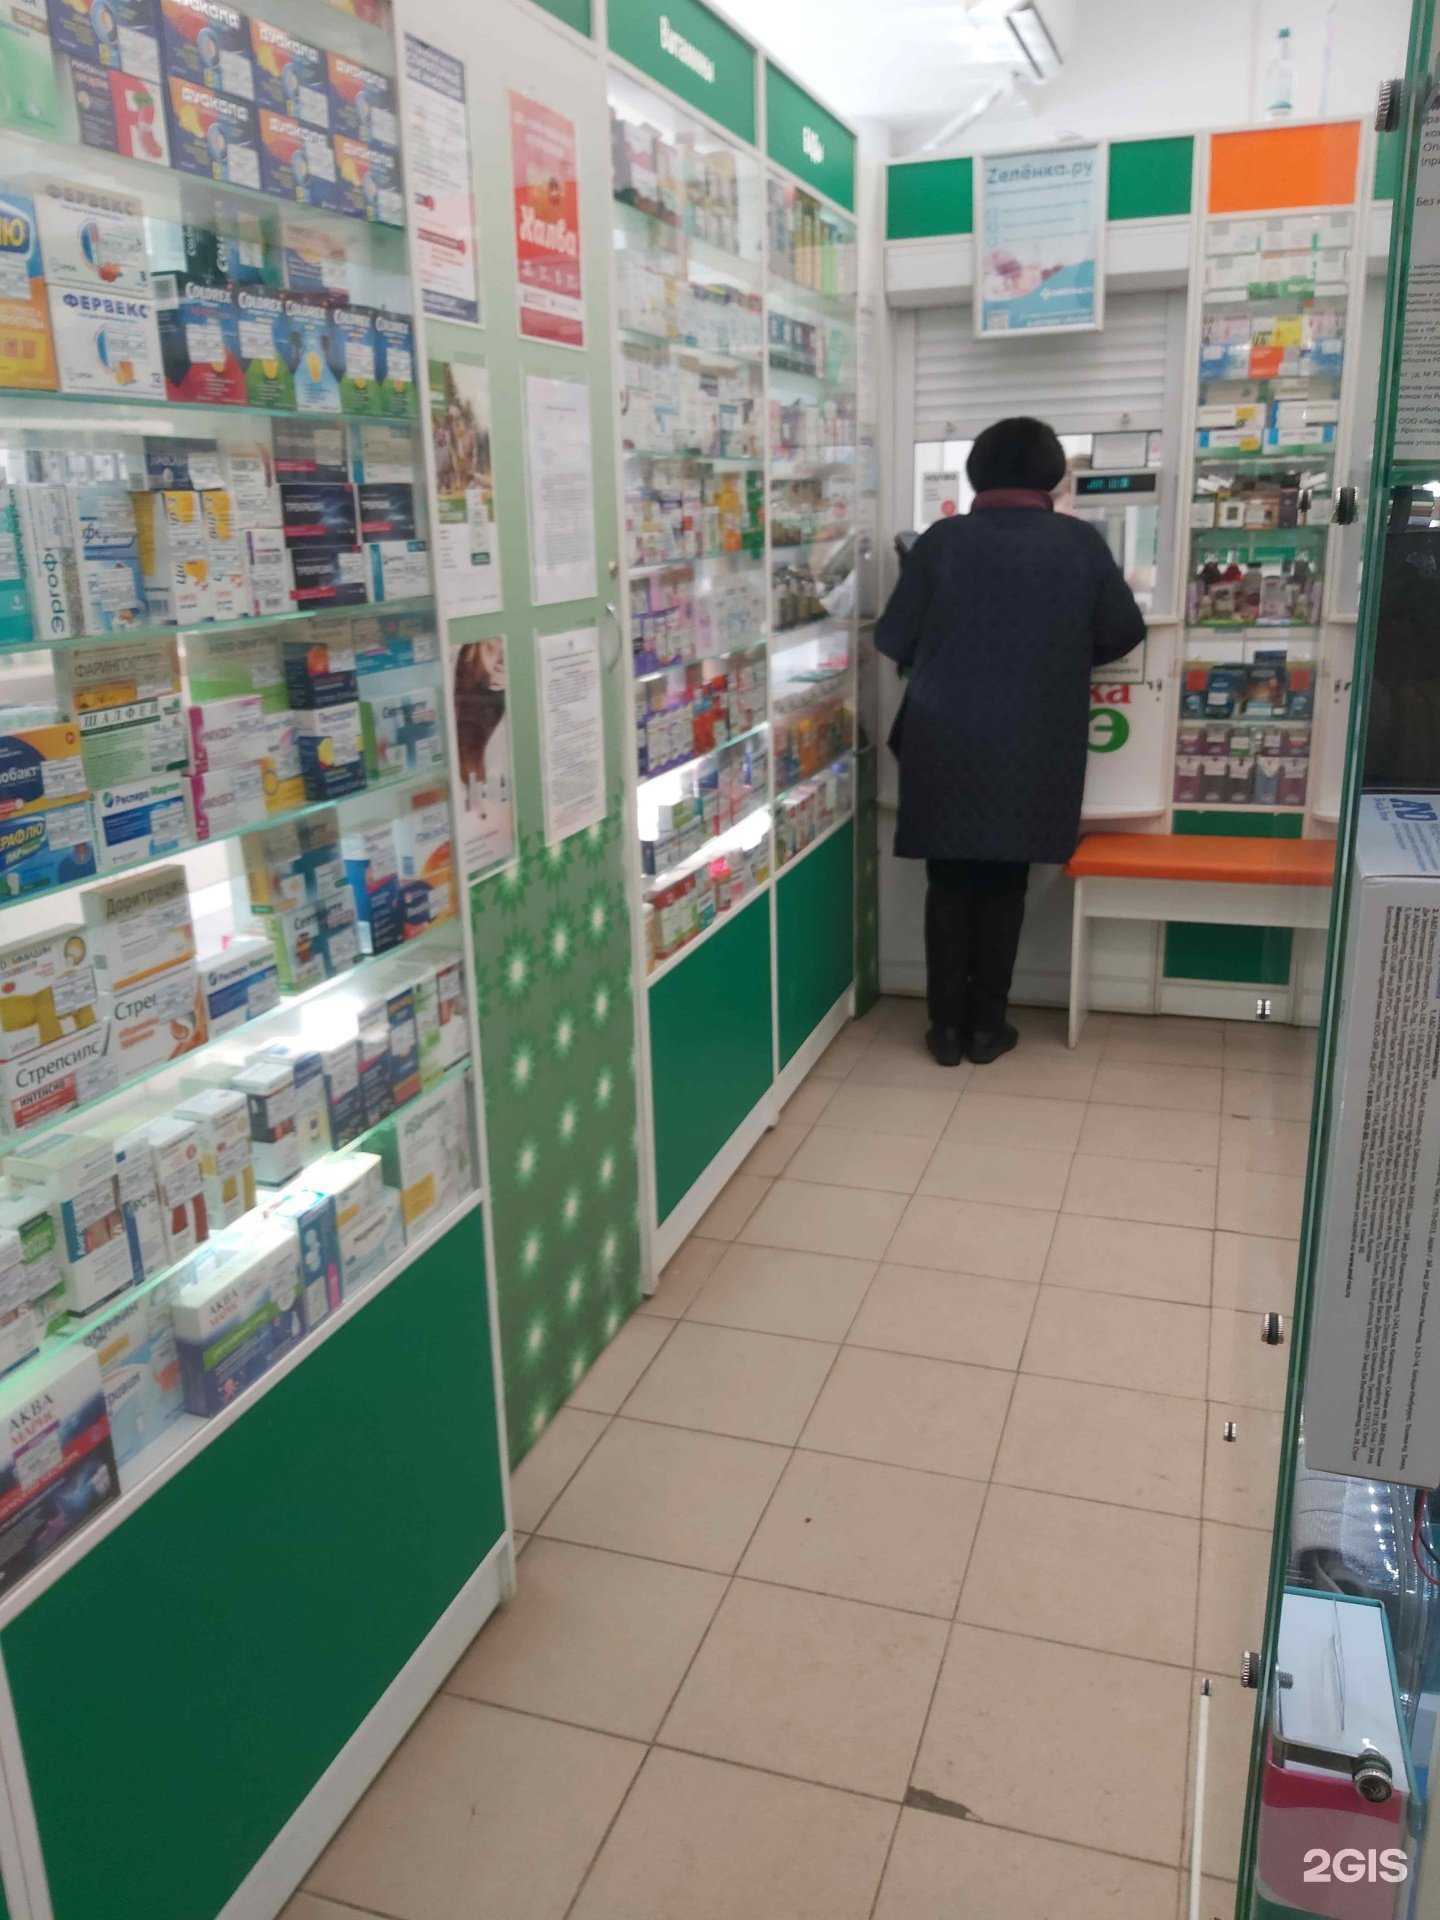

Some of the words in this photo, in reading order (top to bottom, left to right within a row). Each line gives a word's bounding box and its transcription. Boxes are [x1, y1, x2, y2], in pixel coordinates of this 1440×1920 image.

[62, 293, 150, 319] ФЕРВЕКС
[42, 547, 66, 635] Эргоф
[15, 1041, 99, 1088] Стрепсилс
